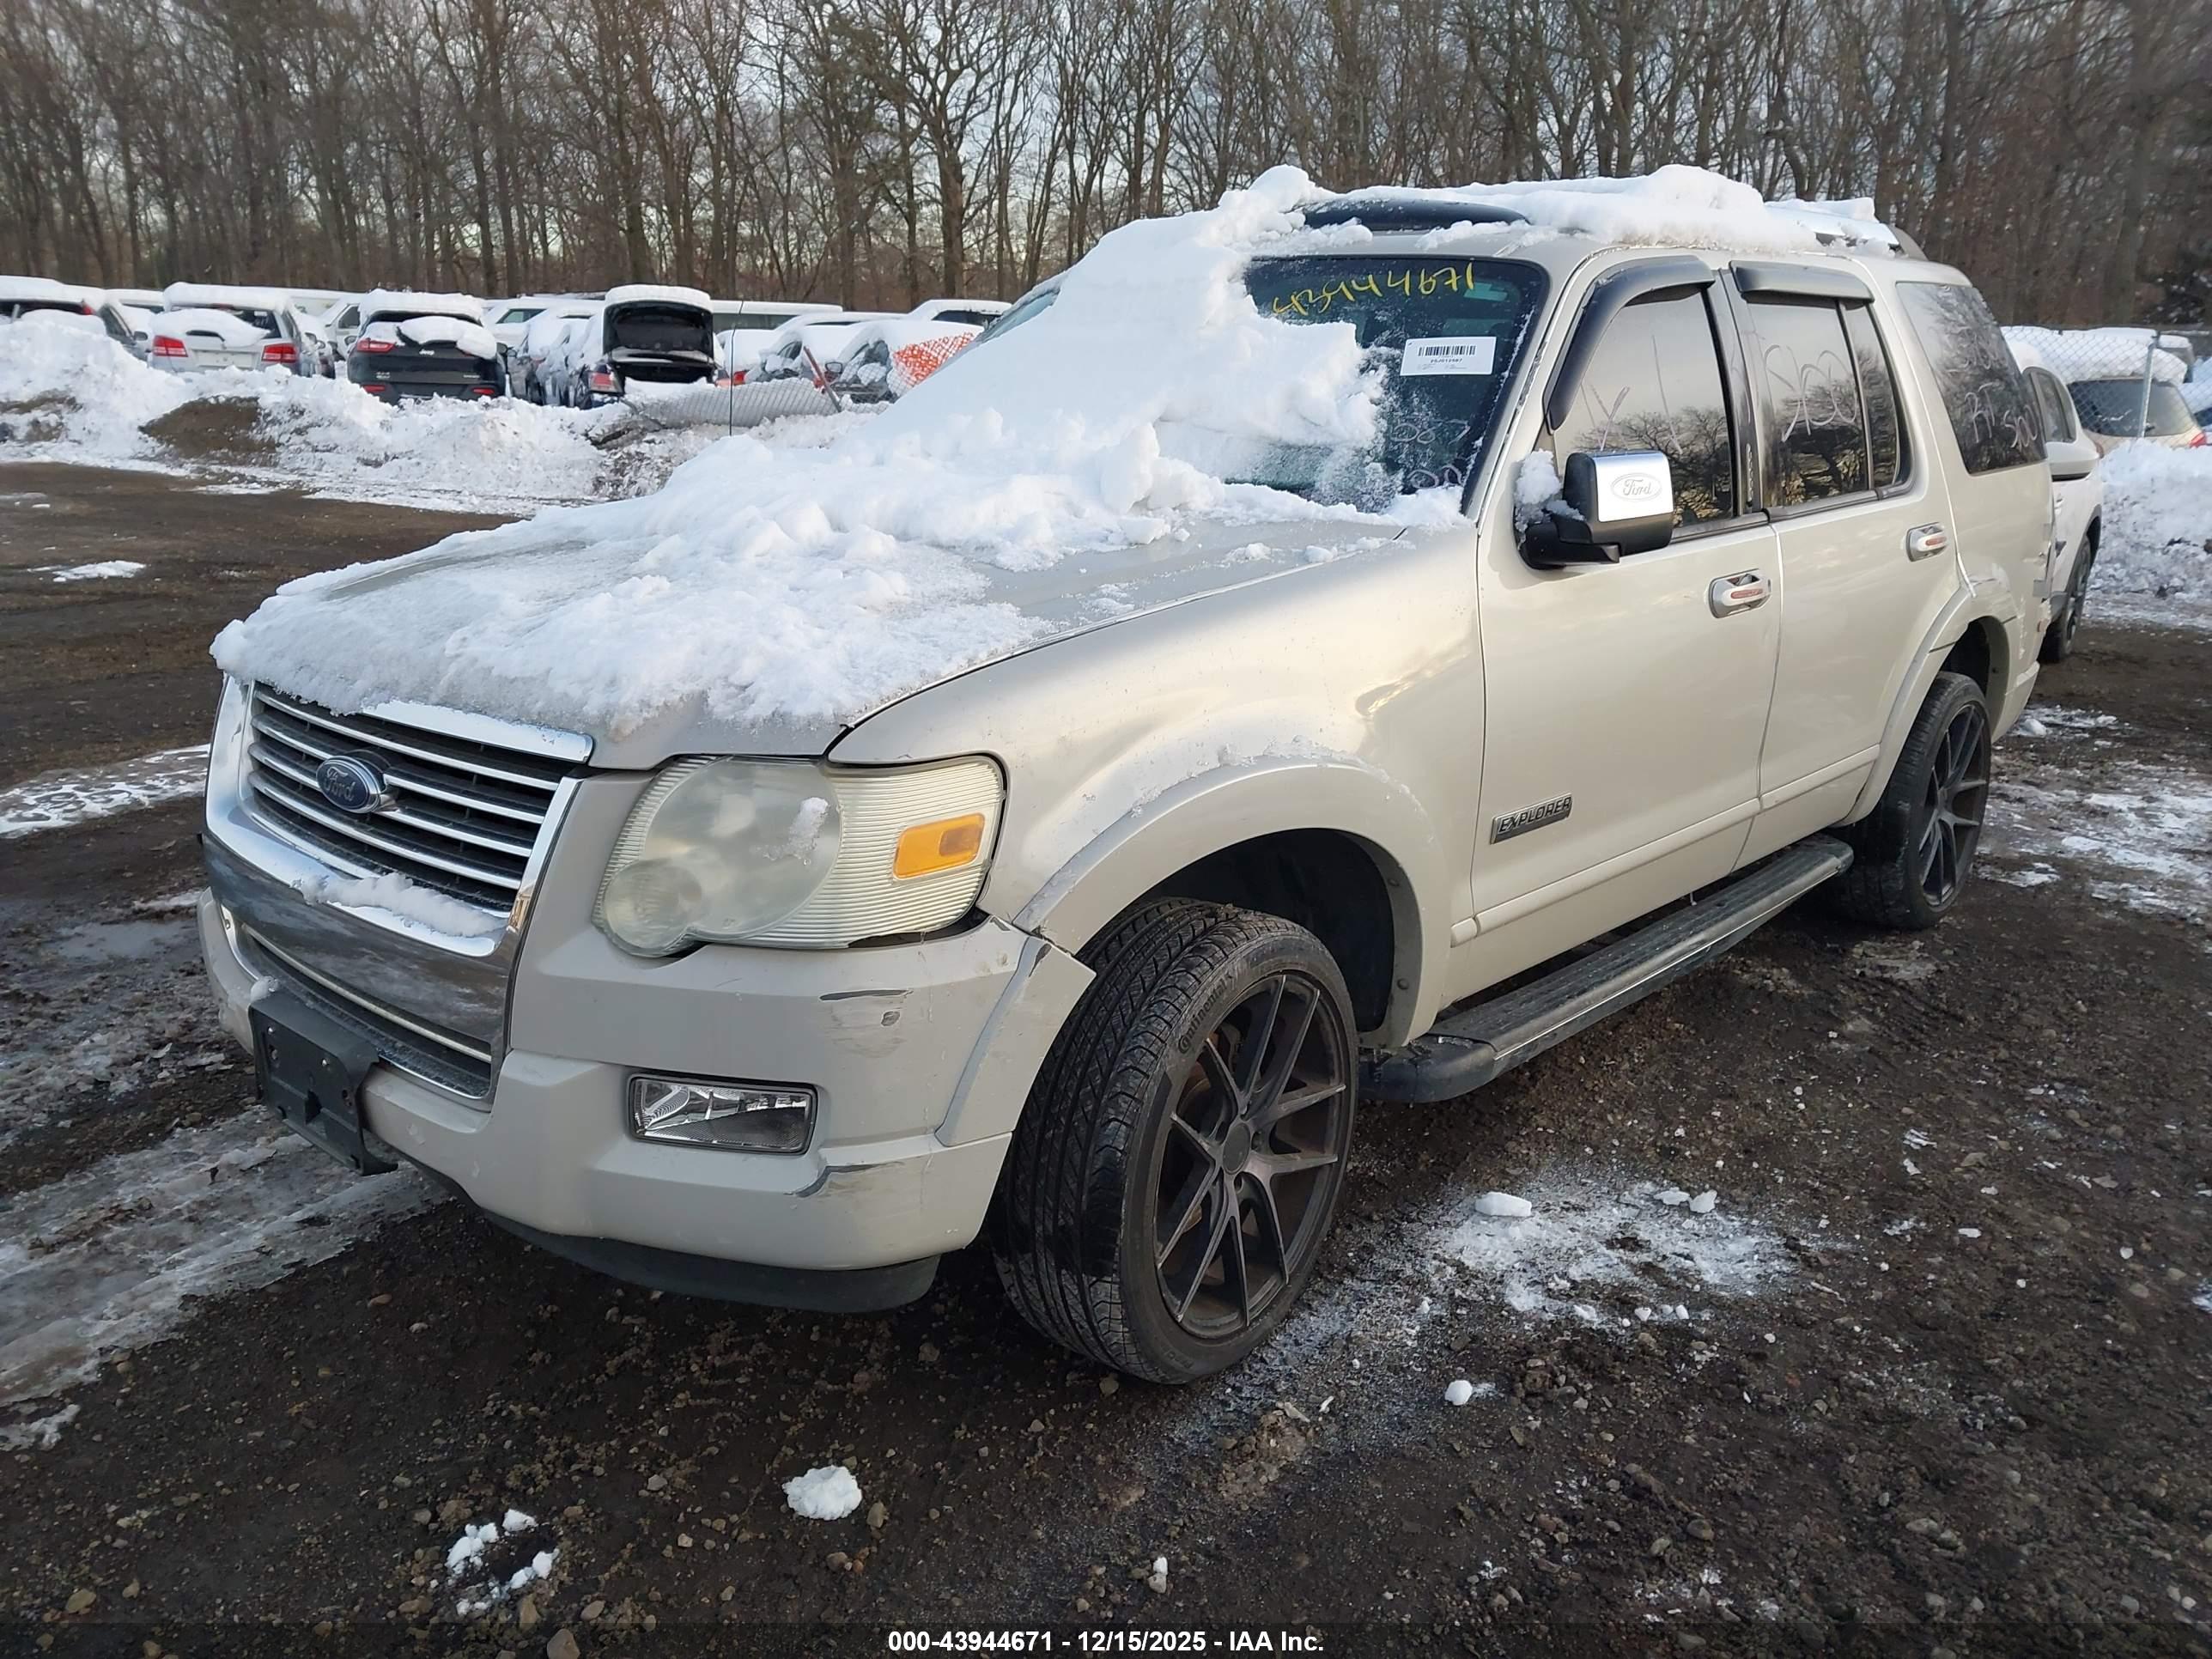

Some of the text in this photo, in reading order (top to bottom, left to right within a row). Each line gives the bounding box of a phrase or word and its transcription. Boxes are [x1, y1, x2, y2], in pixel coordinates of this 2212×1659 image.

[1273, 263, 1474, 316] 43944671
[1623, 478, 1652, 496] Ford
[325, 767, 356, 801] Ford
[1498, 795, 1572, 834] EXPLORER
[1178, 978, 1228, 1054] Continental
